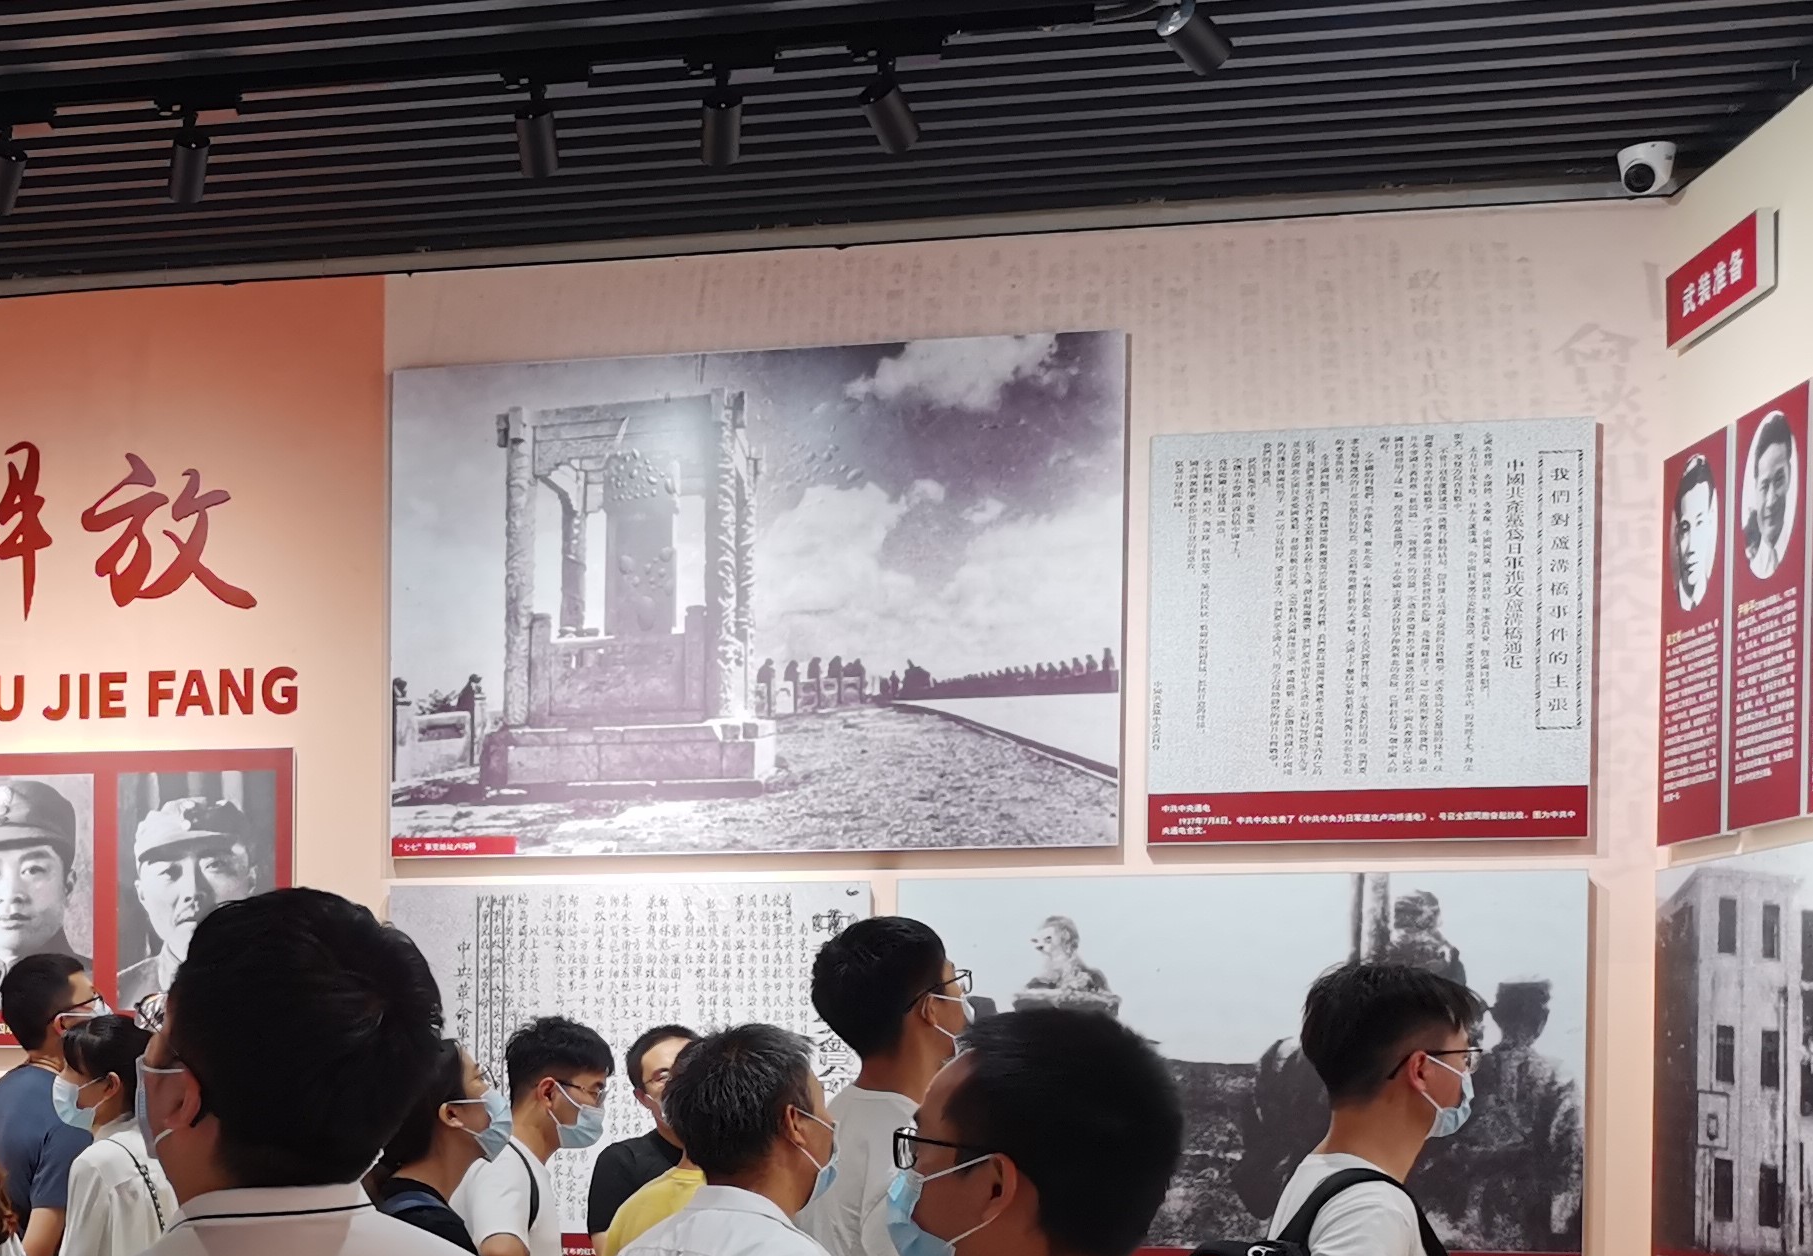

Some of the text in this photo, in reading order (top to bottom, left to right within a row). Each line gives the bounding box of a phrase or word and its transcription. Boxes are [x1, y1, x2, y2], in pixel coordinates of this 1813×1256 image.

[1682, 248, 1744, 317] 武装准备
[42, 672, 128, 721] JIE
[148, 666, 299, 717] FANG
